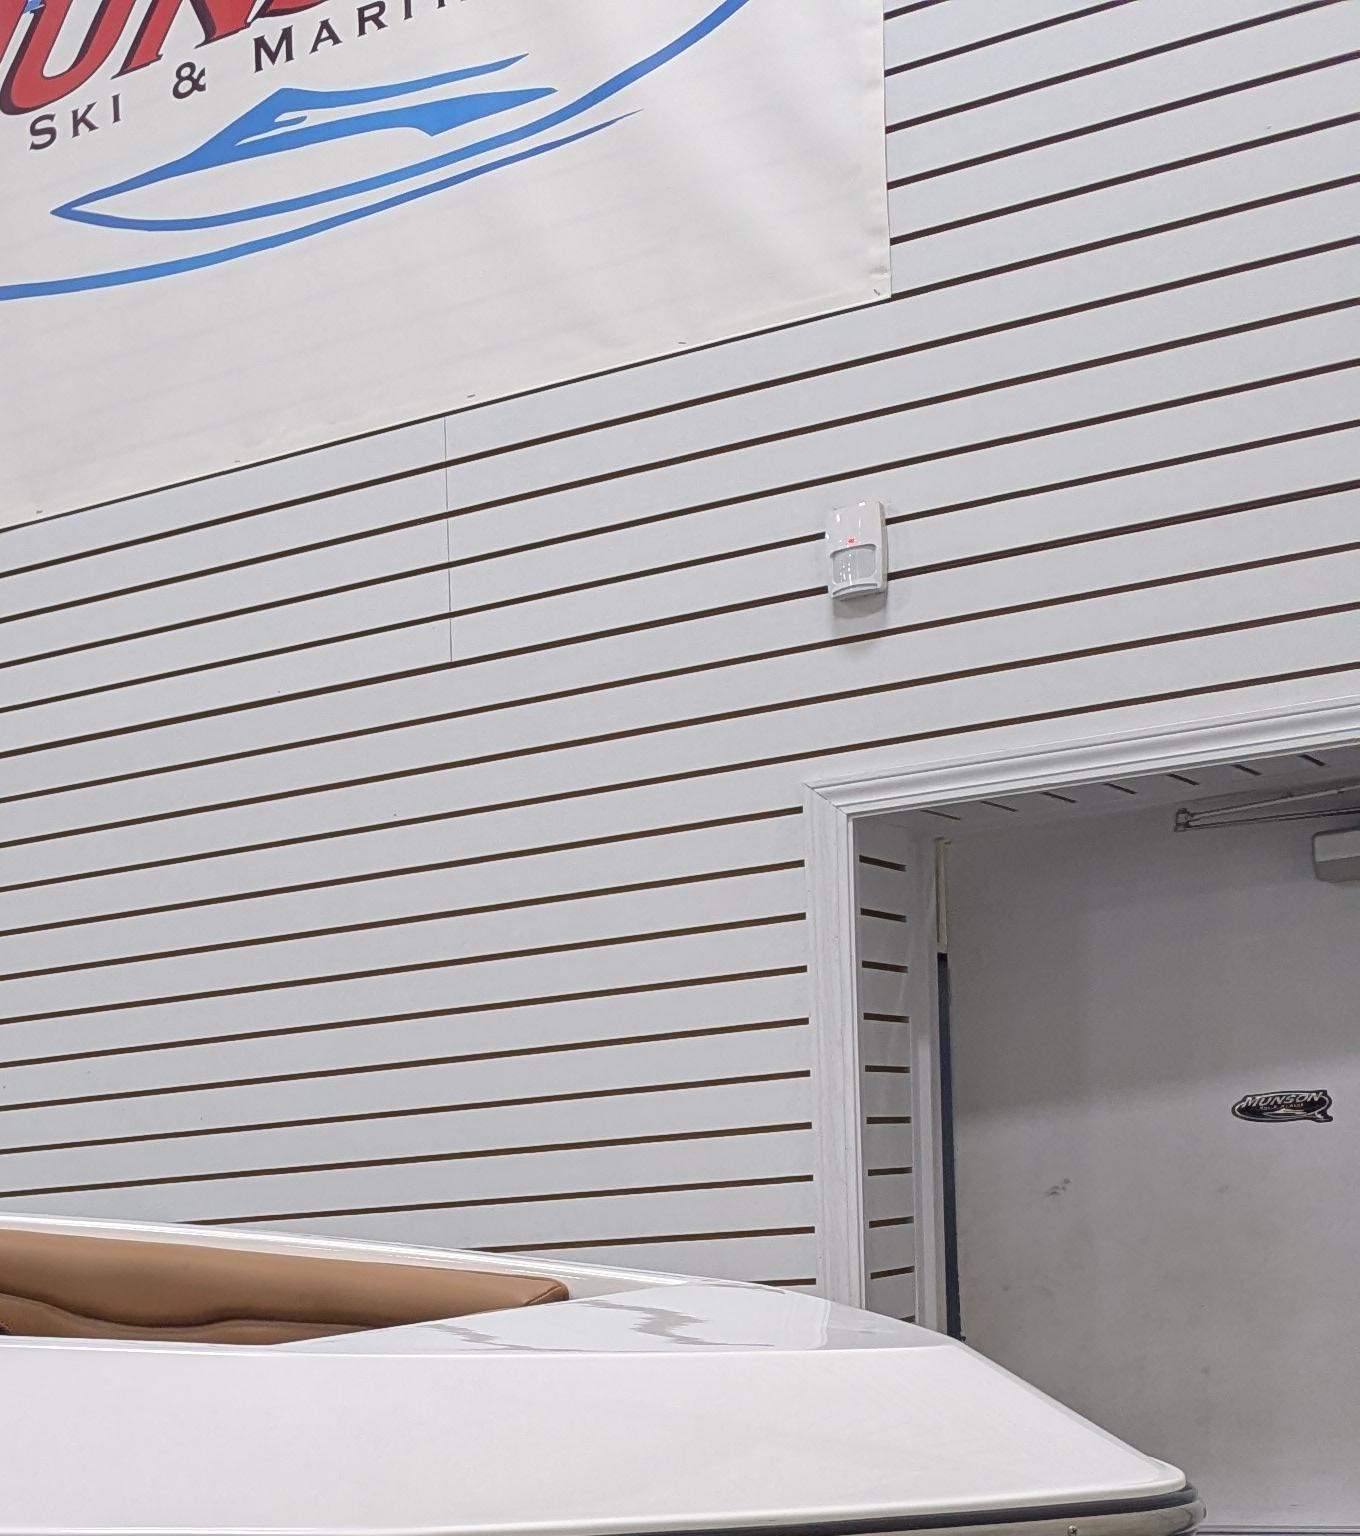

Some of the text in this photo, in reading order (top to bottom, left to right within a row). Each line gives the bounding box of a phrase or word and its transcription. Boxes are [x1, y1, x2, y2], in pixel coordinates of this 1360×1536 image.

[29, 94, 123, 151] SKI
[172, 61, 207, 101] &
[1241, 1091, 1324, 1108] MUNSON
